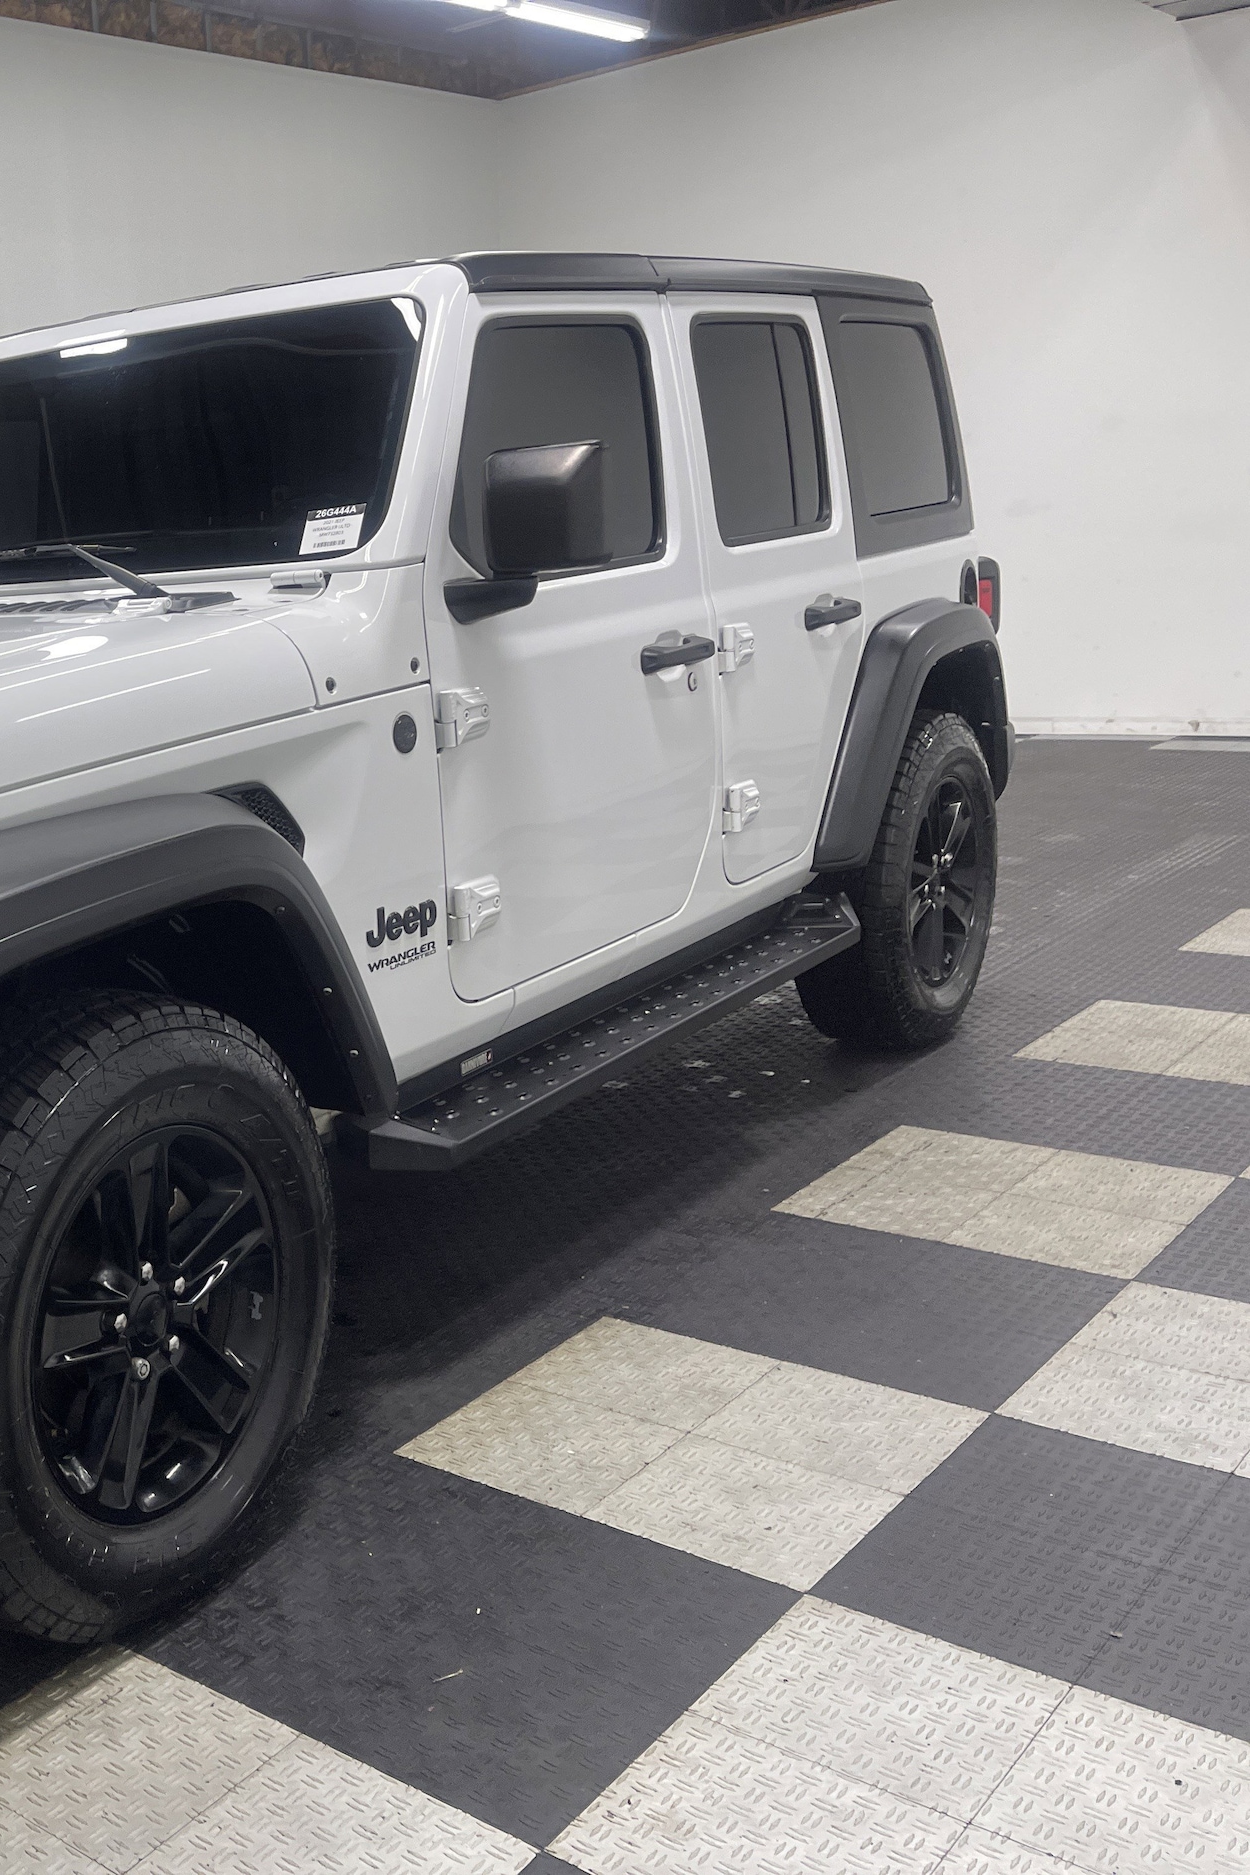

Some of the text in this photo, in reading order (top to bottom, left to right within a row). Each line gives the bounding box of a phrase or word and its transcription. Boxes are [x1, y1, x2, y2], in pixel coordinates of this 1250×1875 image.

[315, 505, 357, 518] 26G444A
[366, 898, 437, 948] Jeep
[367, 940, 436, 973] WRANGLER
[389, 948, 437, 971] UNLIMITED
